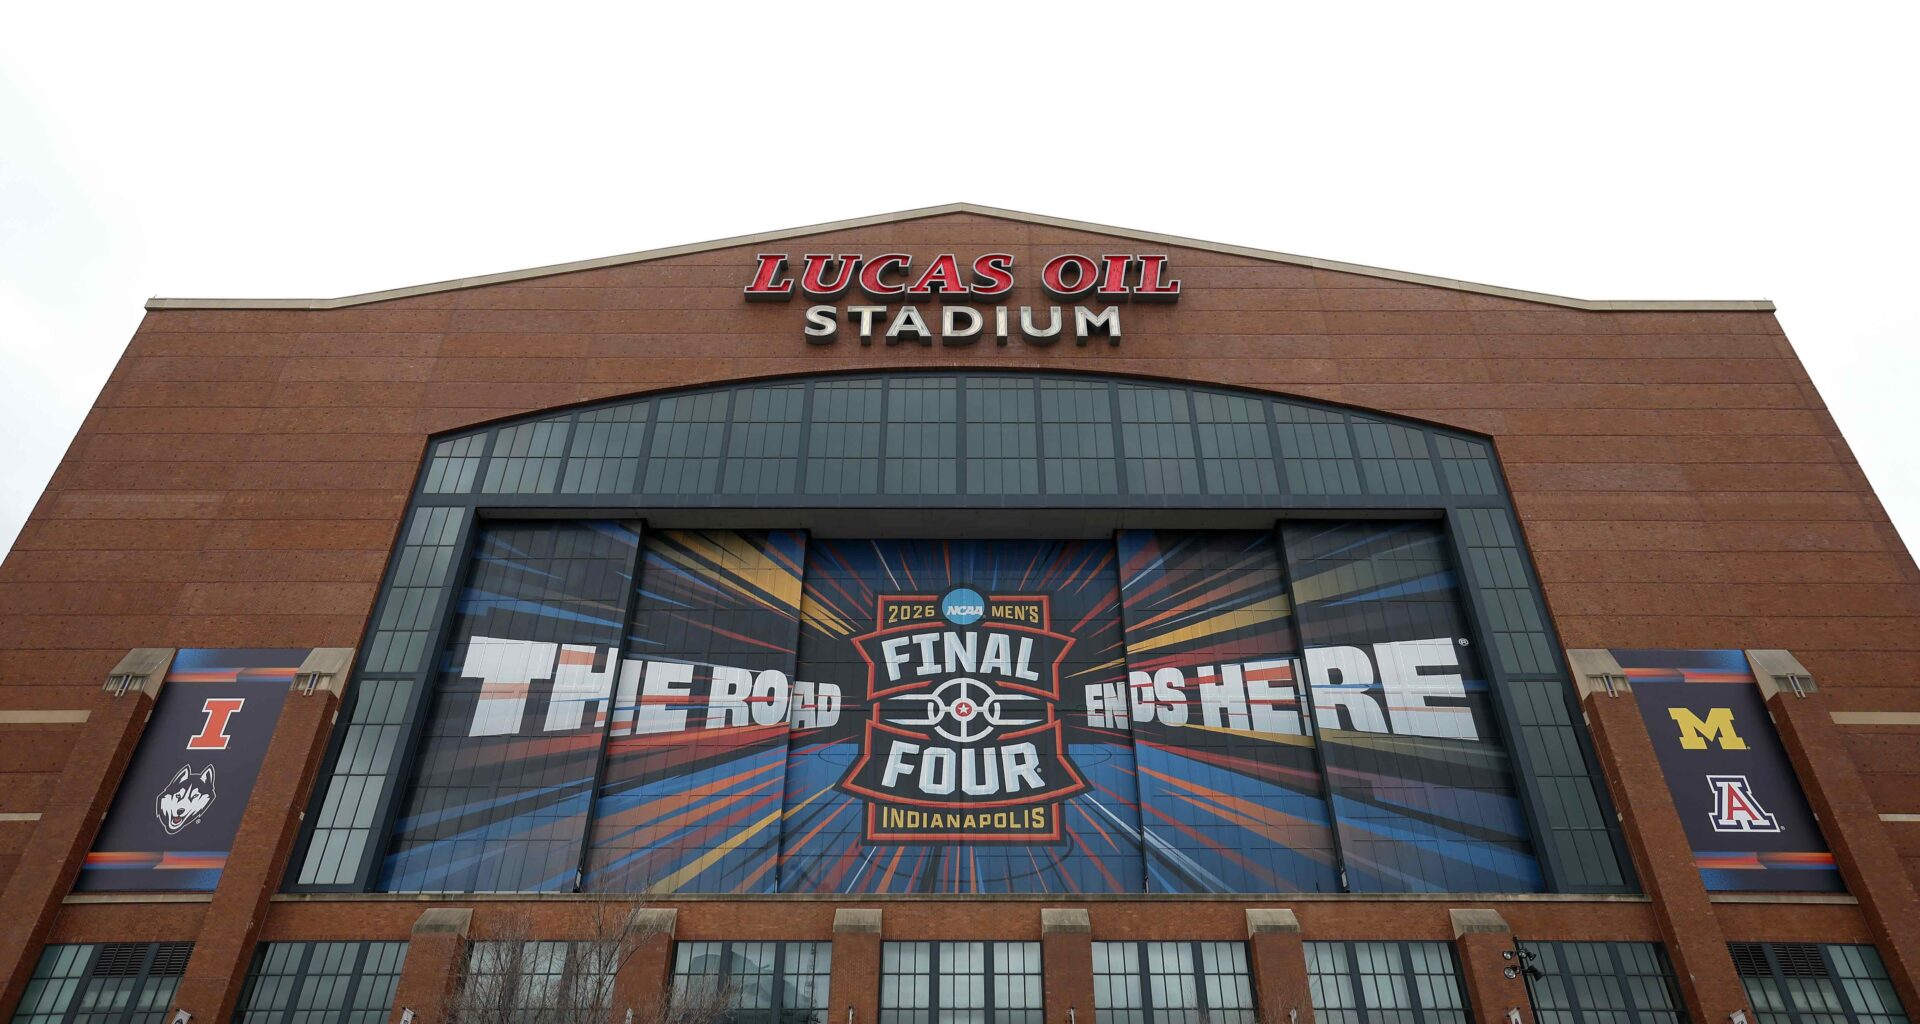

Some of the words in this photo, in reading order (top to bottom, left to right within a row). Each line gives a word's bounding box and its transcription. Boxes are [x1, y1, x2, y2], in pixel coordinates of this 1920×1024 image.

[744, 253, 1015, 302] LUCAS
[1041, 253, 1181, 302] OIL
[804, 305, 1121, 346] STADIUM
[888, 604, 935, 623] 2026
[991, 605, 1039, 623] MEN'S
[946, 605, 984, 616] NCAA
[881, 631, 1039, 682] FINAL
[461, 635, 694, 737] THE
[705, 665, 841, 729] ROAD
[1085, 667, 1188, 730] ENDS
[1197, 637, 1479, 741] HERE
[186, 698, 245, 749] I
[1668, 707, 1747, 749] M
[881, 740, 1046, 796] FOUR
[882, 806, 1045, 829] INDIANAPOLIS
[1706, 775, 1781, 833] A
